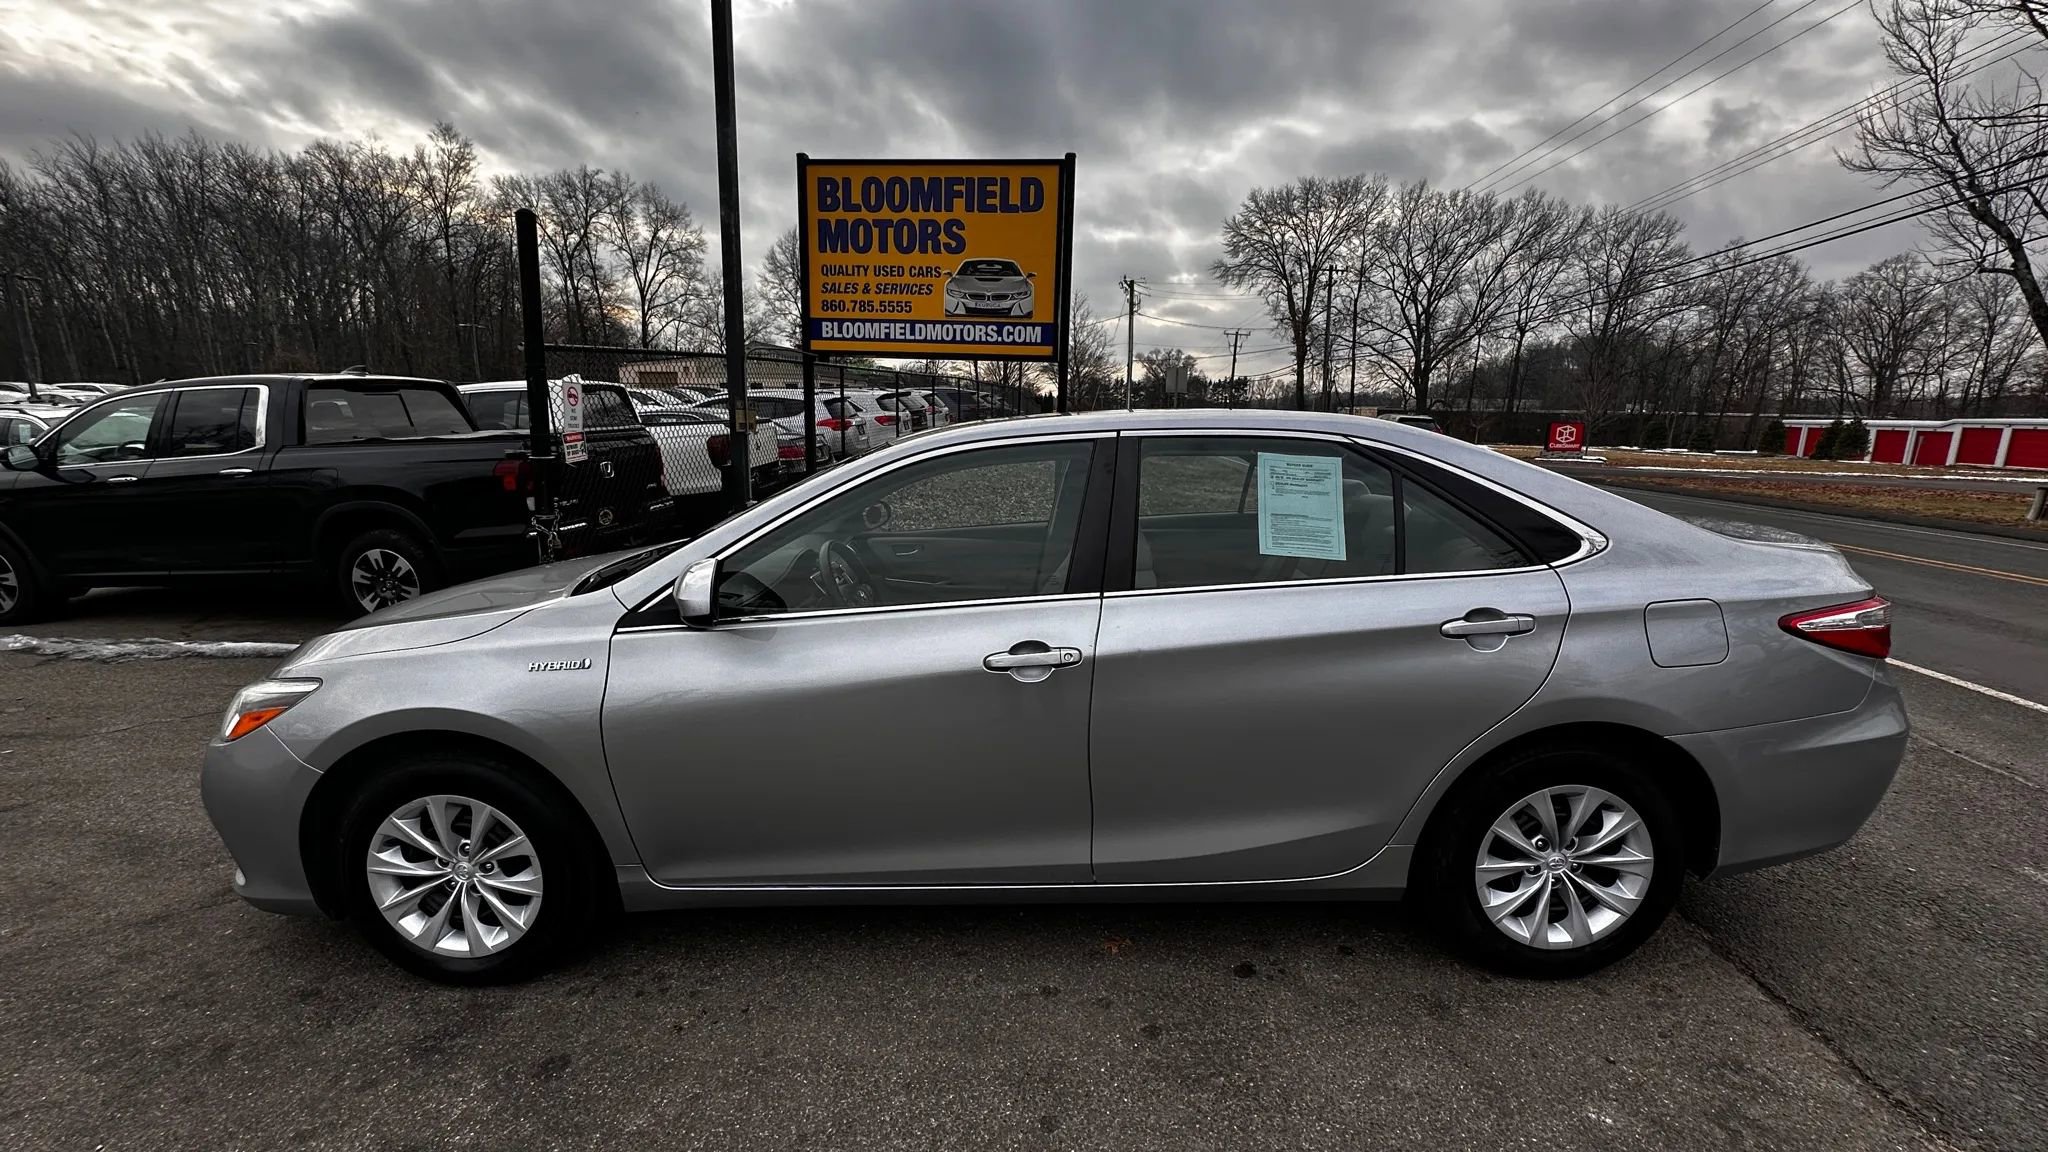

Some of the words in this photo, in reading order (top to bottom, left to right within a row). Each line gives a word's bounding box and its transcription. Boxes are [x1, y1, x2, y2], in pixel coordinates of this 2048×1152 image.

[817, 176, 1045, 214] BLOOMFIELD
[818, 218, 966, 254] MOTORS
[821, 264, 869, 278] QUALITY
[873, 265, 905, 278] USED
[909, 265, 942, 278] CARS
[821, 282, 858, 294] SALES
[862, 283, 871, 294] &
[874, 283, 933, 295] SERVICES
[821, 299, 912, 314] 860.785.5555
[821, 321, 1042, 343] BLOOMFIELDMOTORS.COM
[528, 660, 581, 672] HYBRID
